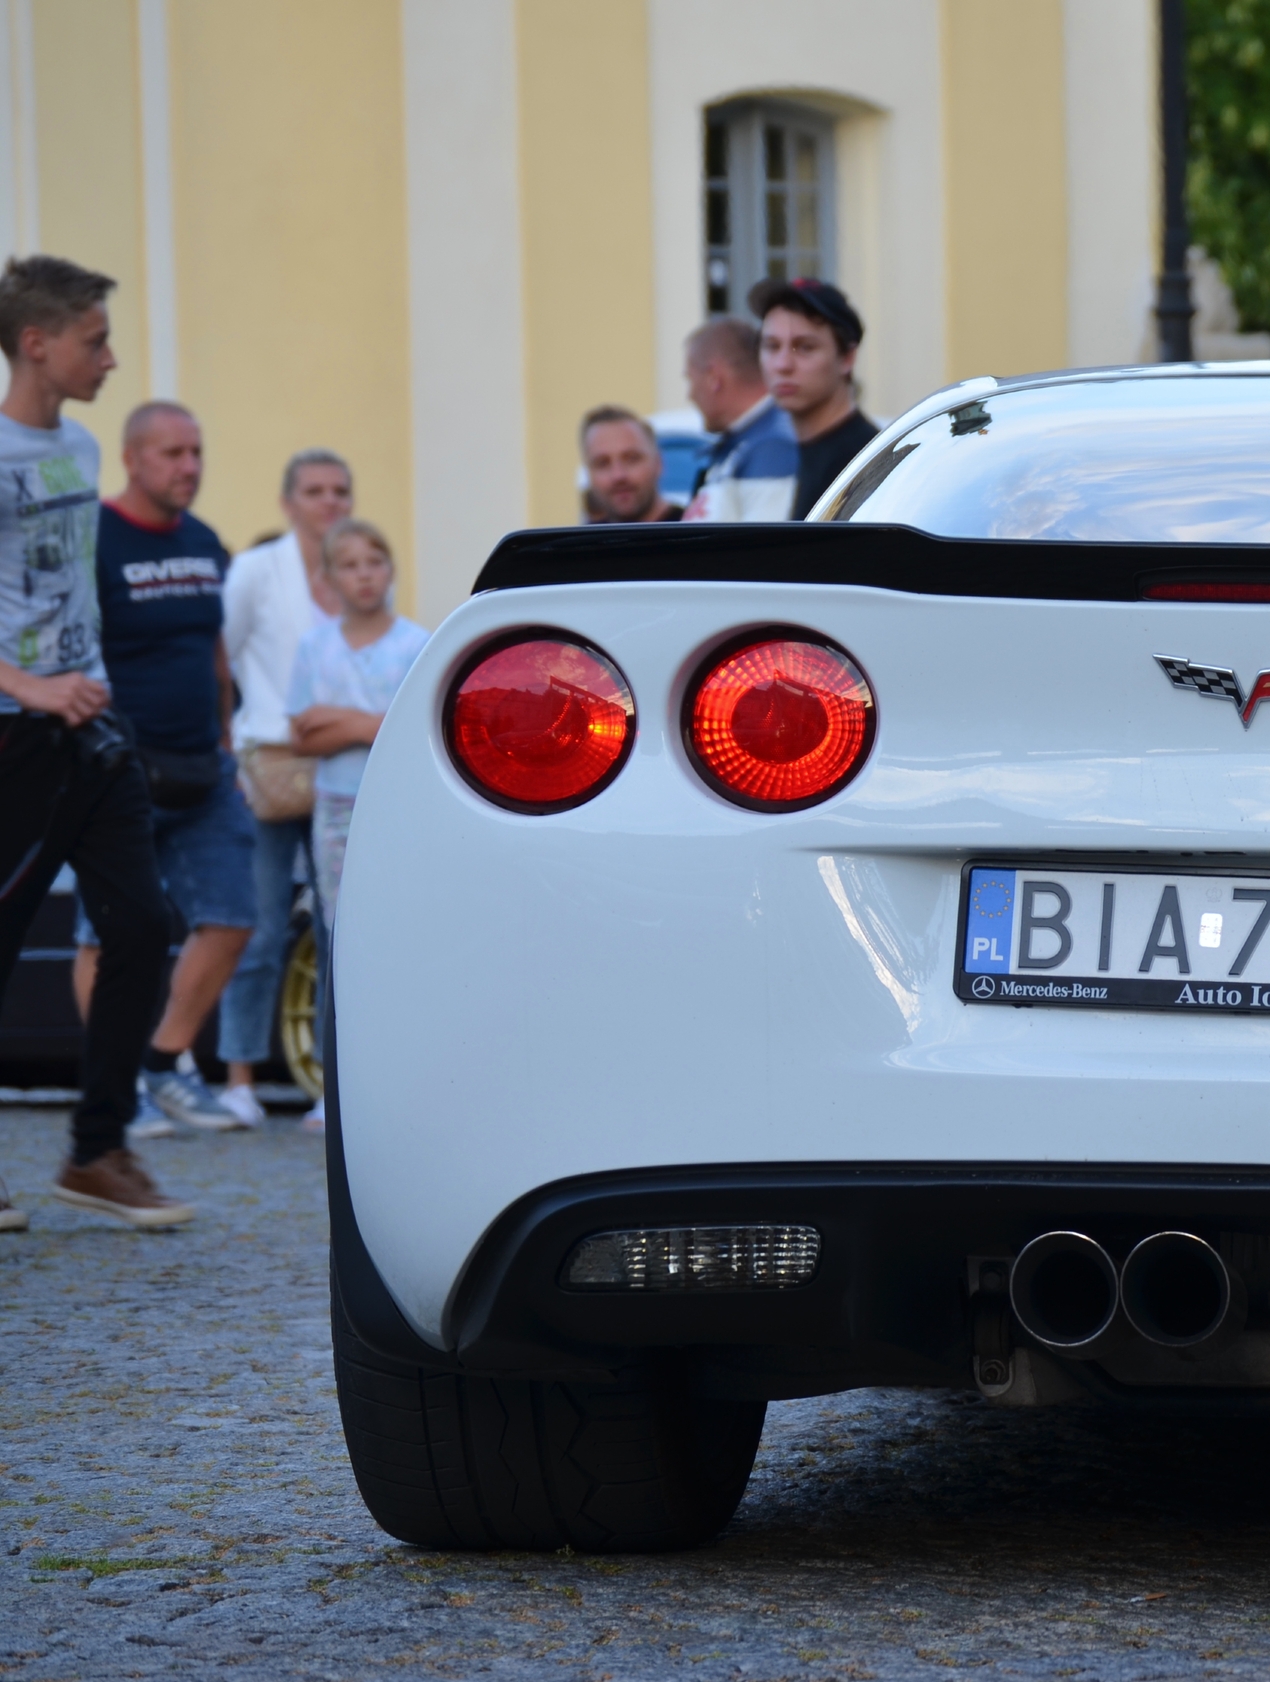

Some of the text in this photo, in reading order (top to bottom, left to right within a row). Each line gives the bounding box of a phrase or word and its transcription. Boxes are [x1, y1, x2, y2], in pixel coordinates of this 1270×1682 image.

[1017, 880, 1192, 975] BIA
[971, 937, 1005, 962] PL
[999, 980, 1108, 1000] Mercedes-Benz
[1174, 983, 1242, 1006] Auto
